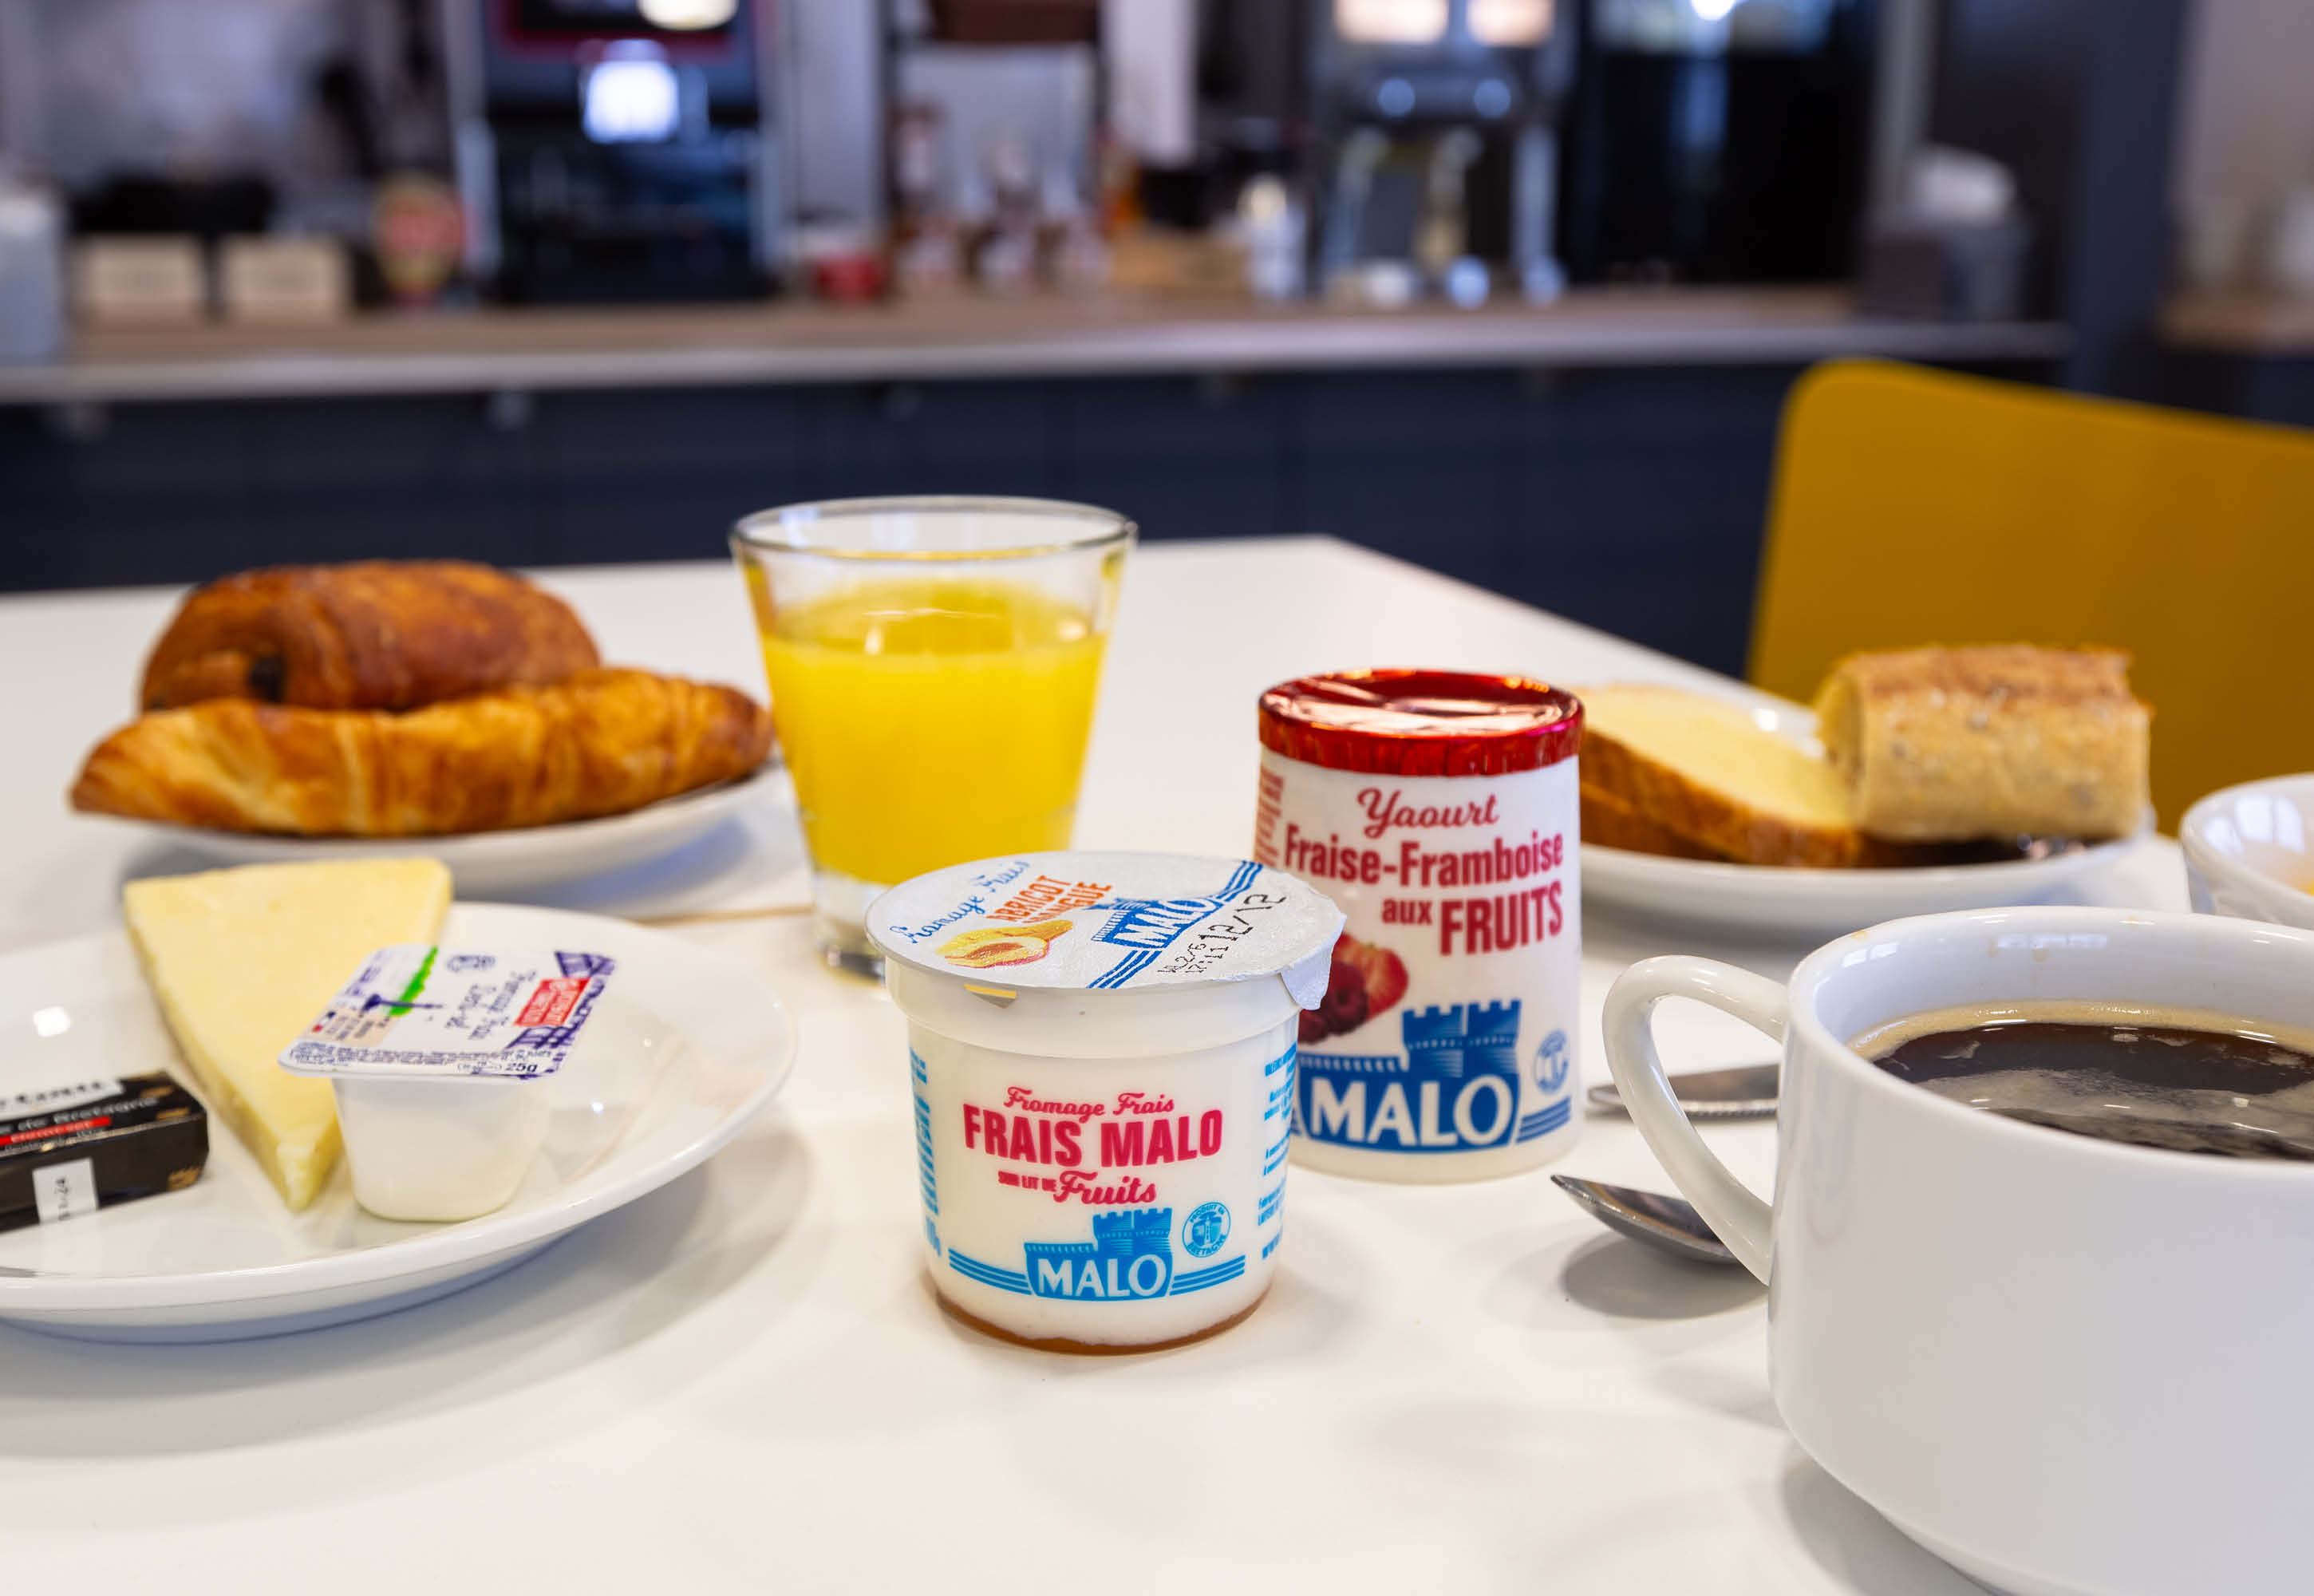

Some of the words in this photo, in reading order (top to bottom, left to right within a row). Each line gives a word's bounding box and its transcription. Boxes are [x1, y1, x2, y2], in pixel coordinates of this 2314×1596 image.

[1356, 788, 1499, 839] Yaourt
[1285, 823, 1563, 887] Fraise-Framboise
[986, 875, 1071, 923] ABRICOT
[1113, 899, 1218, 947] MALO
[1198, 894, 1288, 942] 12/12
[1381, 898, 1433, 925] aux
[1440, 880, 1563, 956] FRUITS
[1004, 1086, 1105, 1124] Fromage
[1113, 1092, 1175, 1116] Frais
[1310, 1073, 1514, 1146] MALO
[963, 1104, 1082, 1167] FRAIS
[1100, 1109, 1223, 1167] MALO
[1053, 1170, 1157, 1205] Fruits
[1037, 1254, 1167, 1298] MALO
